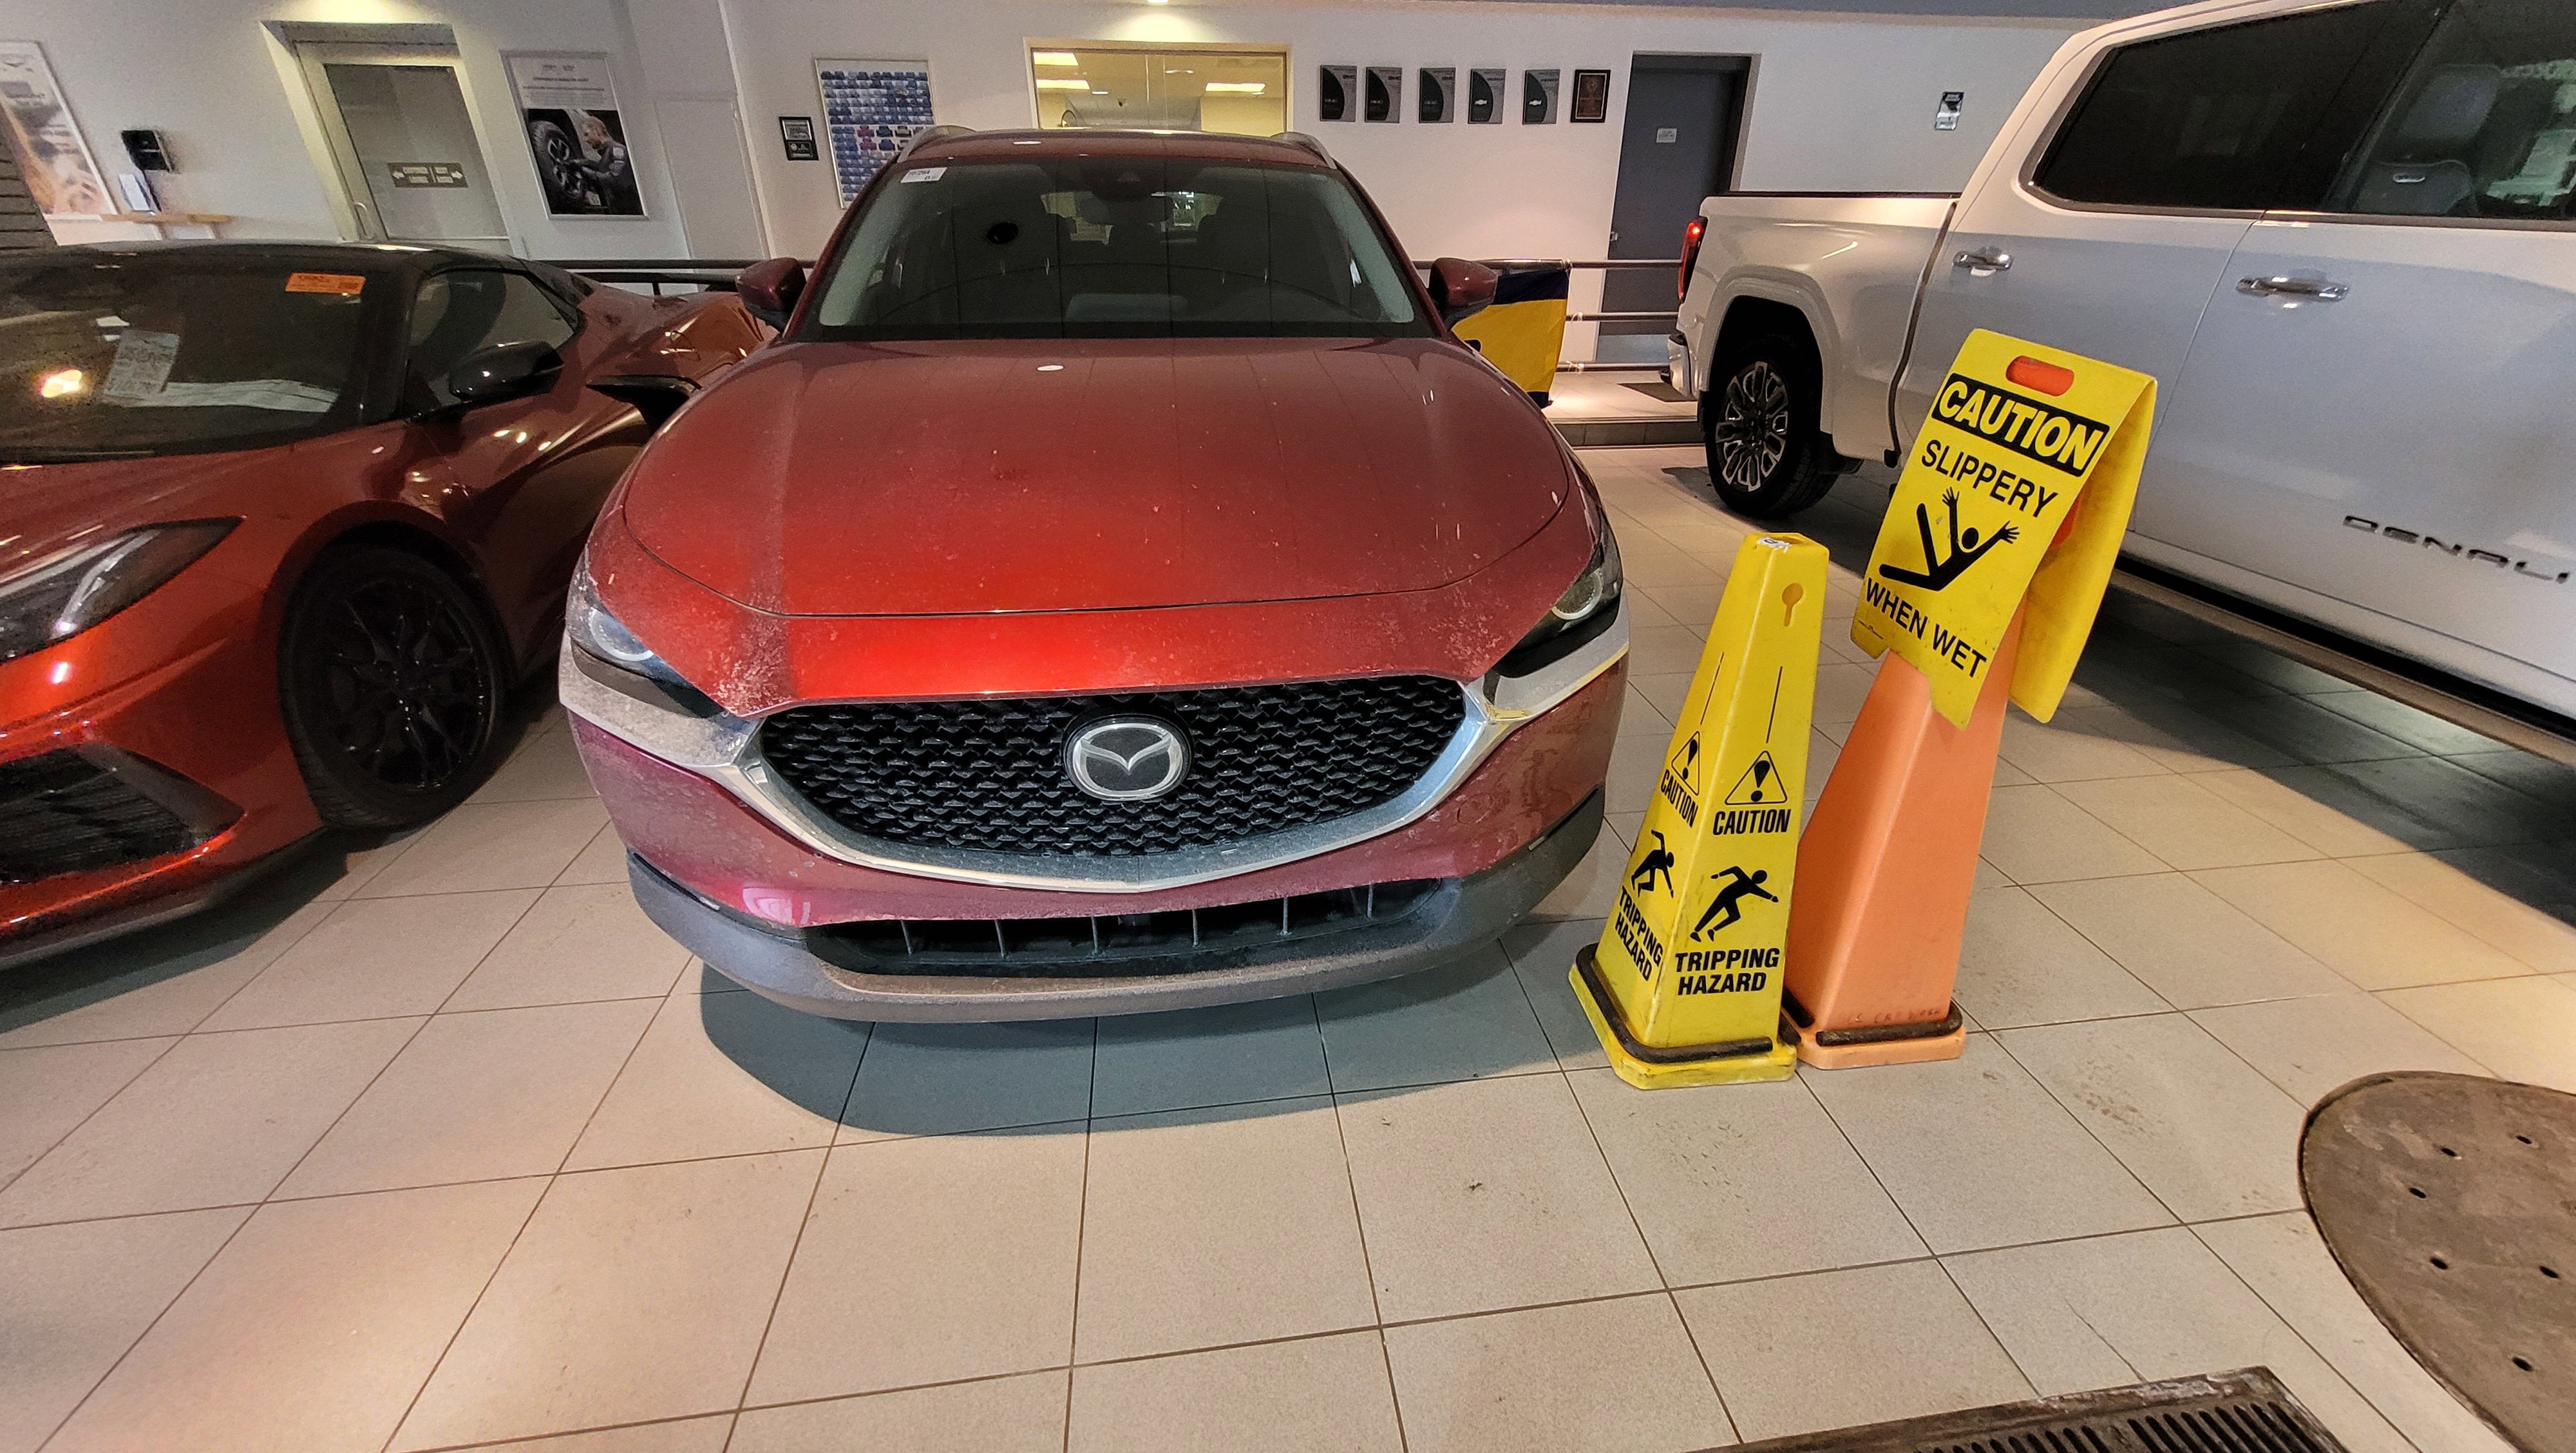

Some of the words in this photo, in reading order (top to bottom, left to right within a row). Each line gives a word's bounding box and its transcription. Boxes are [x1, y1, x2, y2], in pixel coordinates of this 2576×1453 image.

[1939, 381, 2104, 470] CAUTION
[1922, 439, 2058, 518] SLIPPERY
[2343, 515, 2570, 584] DENALI
[1866, 577, 1928, 640] WHEN
[1933, 623, 1987, 678] WET
[1660, 769, 1698, 828] CAUTION
[1712, 809, 1791, 835] CAUTION
[1615, 911, 1653, 981] HAZARD
[1620, 885, 1663, 967] TRIPPING
[1675, 947, 1780, 973] TRIPPING
[1678, 972, 1766, 996] HAZARD
